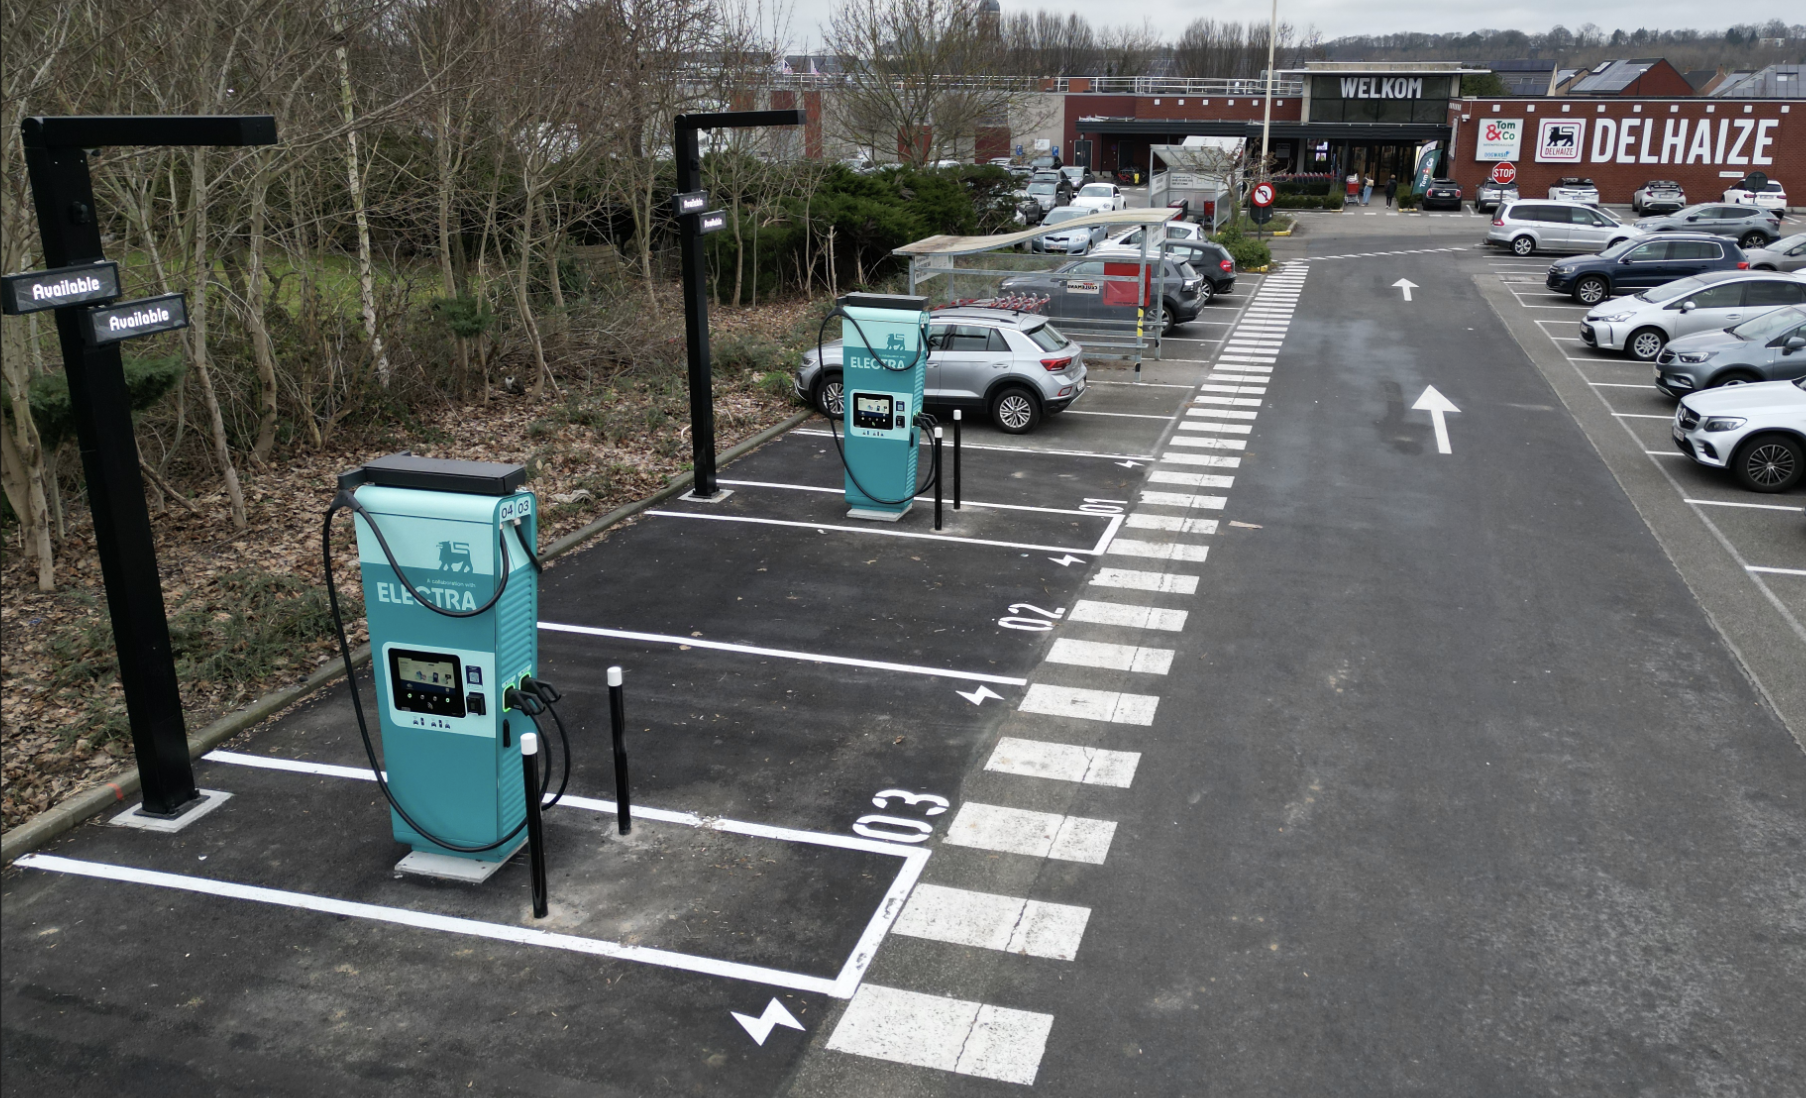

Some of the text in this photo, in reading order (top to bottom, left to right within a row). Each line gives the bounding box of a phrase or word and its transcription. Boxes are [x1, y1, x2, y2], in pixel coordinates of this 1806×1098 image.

[1340, 77, 1423, 99] WELKOM
[1486, 124, 1515, 141] & Co
[1496, 121, 1516, 130] Tom
[1544, 147, 1574, 156] DELHAIZE
[1590, 118, 1779, 165] DELHAIZE
[1419, 174, 1429, 188] Tom
[1426, 157, 1435, 167] Co
[1493, 168, 1514, 178] STOP
[32, 276, 100, 301] Available
[109, 308, 170, 332] Available
[850, 356, 905, 371] ELECTRA
[501, 500, 529, 519] 04 03
[1078, 497, 1129, 514] 01
[432, 579, 464, 587] collaboration
[376, 581, 477, 611] ELECTRA
[997, 603, 1066, 632] 02
[852, 788, 951, 844] 03
